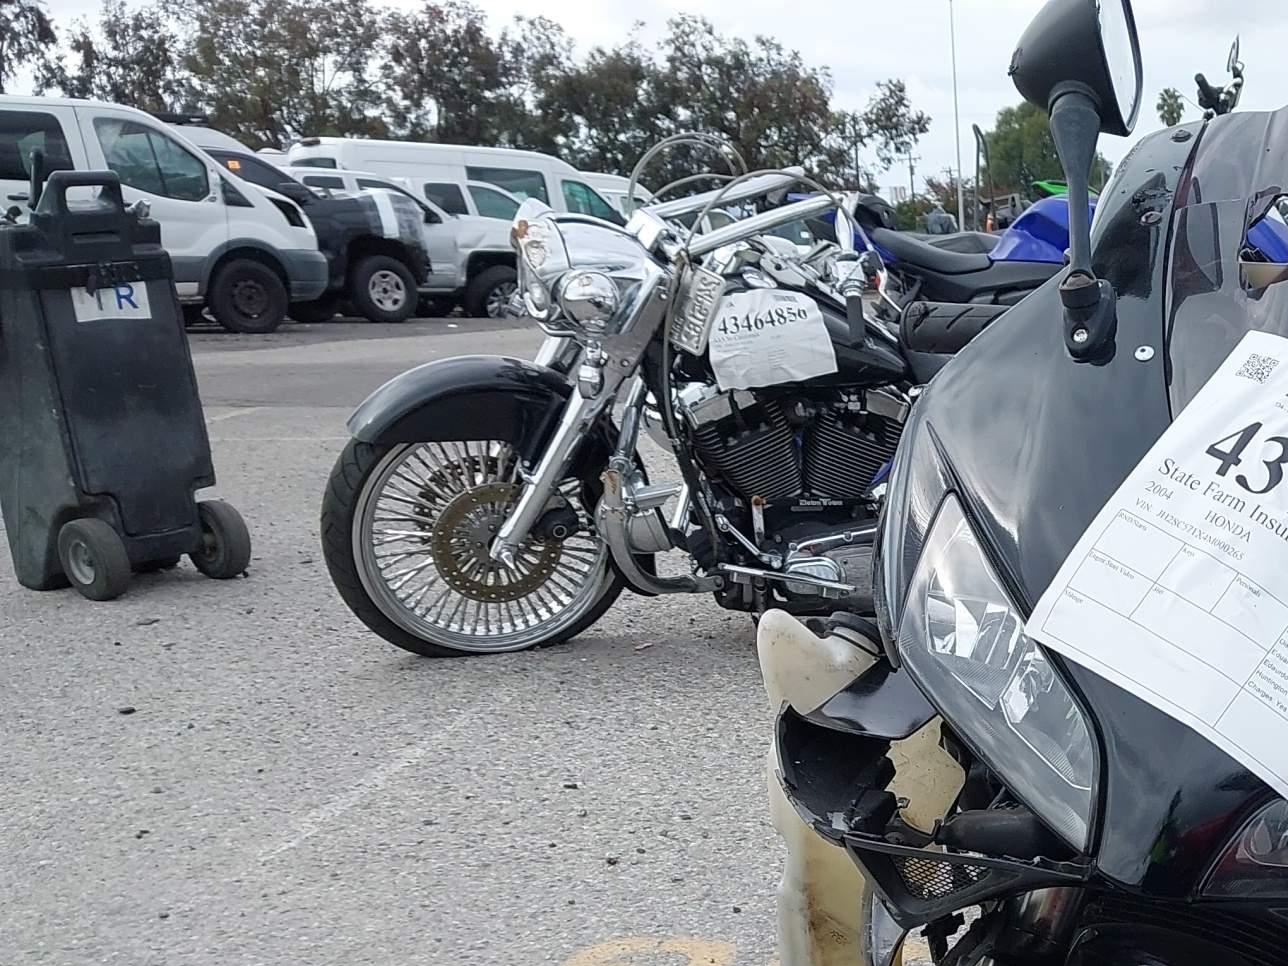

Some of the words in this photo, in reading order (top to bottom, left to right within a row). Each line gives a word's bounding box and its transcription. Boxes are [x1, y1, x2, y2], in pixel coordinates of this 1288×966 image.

[1144, 480, 1174, 501] 2004
[1204, 510, 1252, 543] HONDA
[1158, 457, 1201, 491] State
[1203, 480, 1247, 514] Farm
